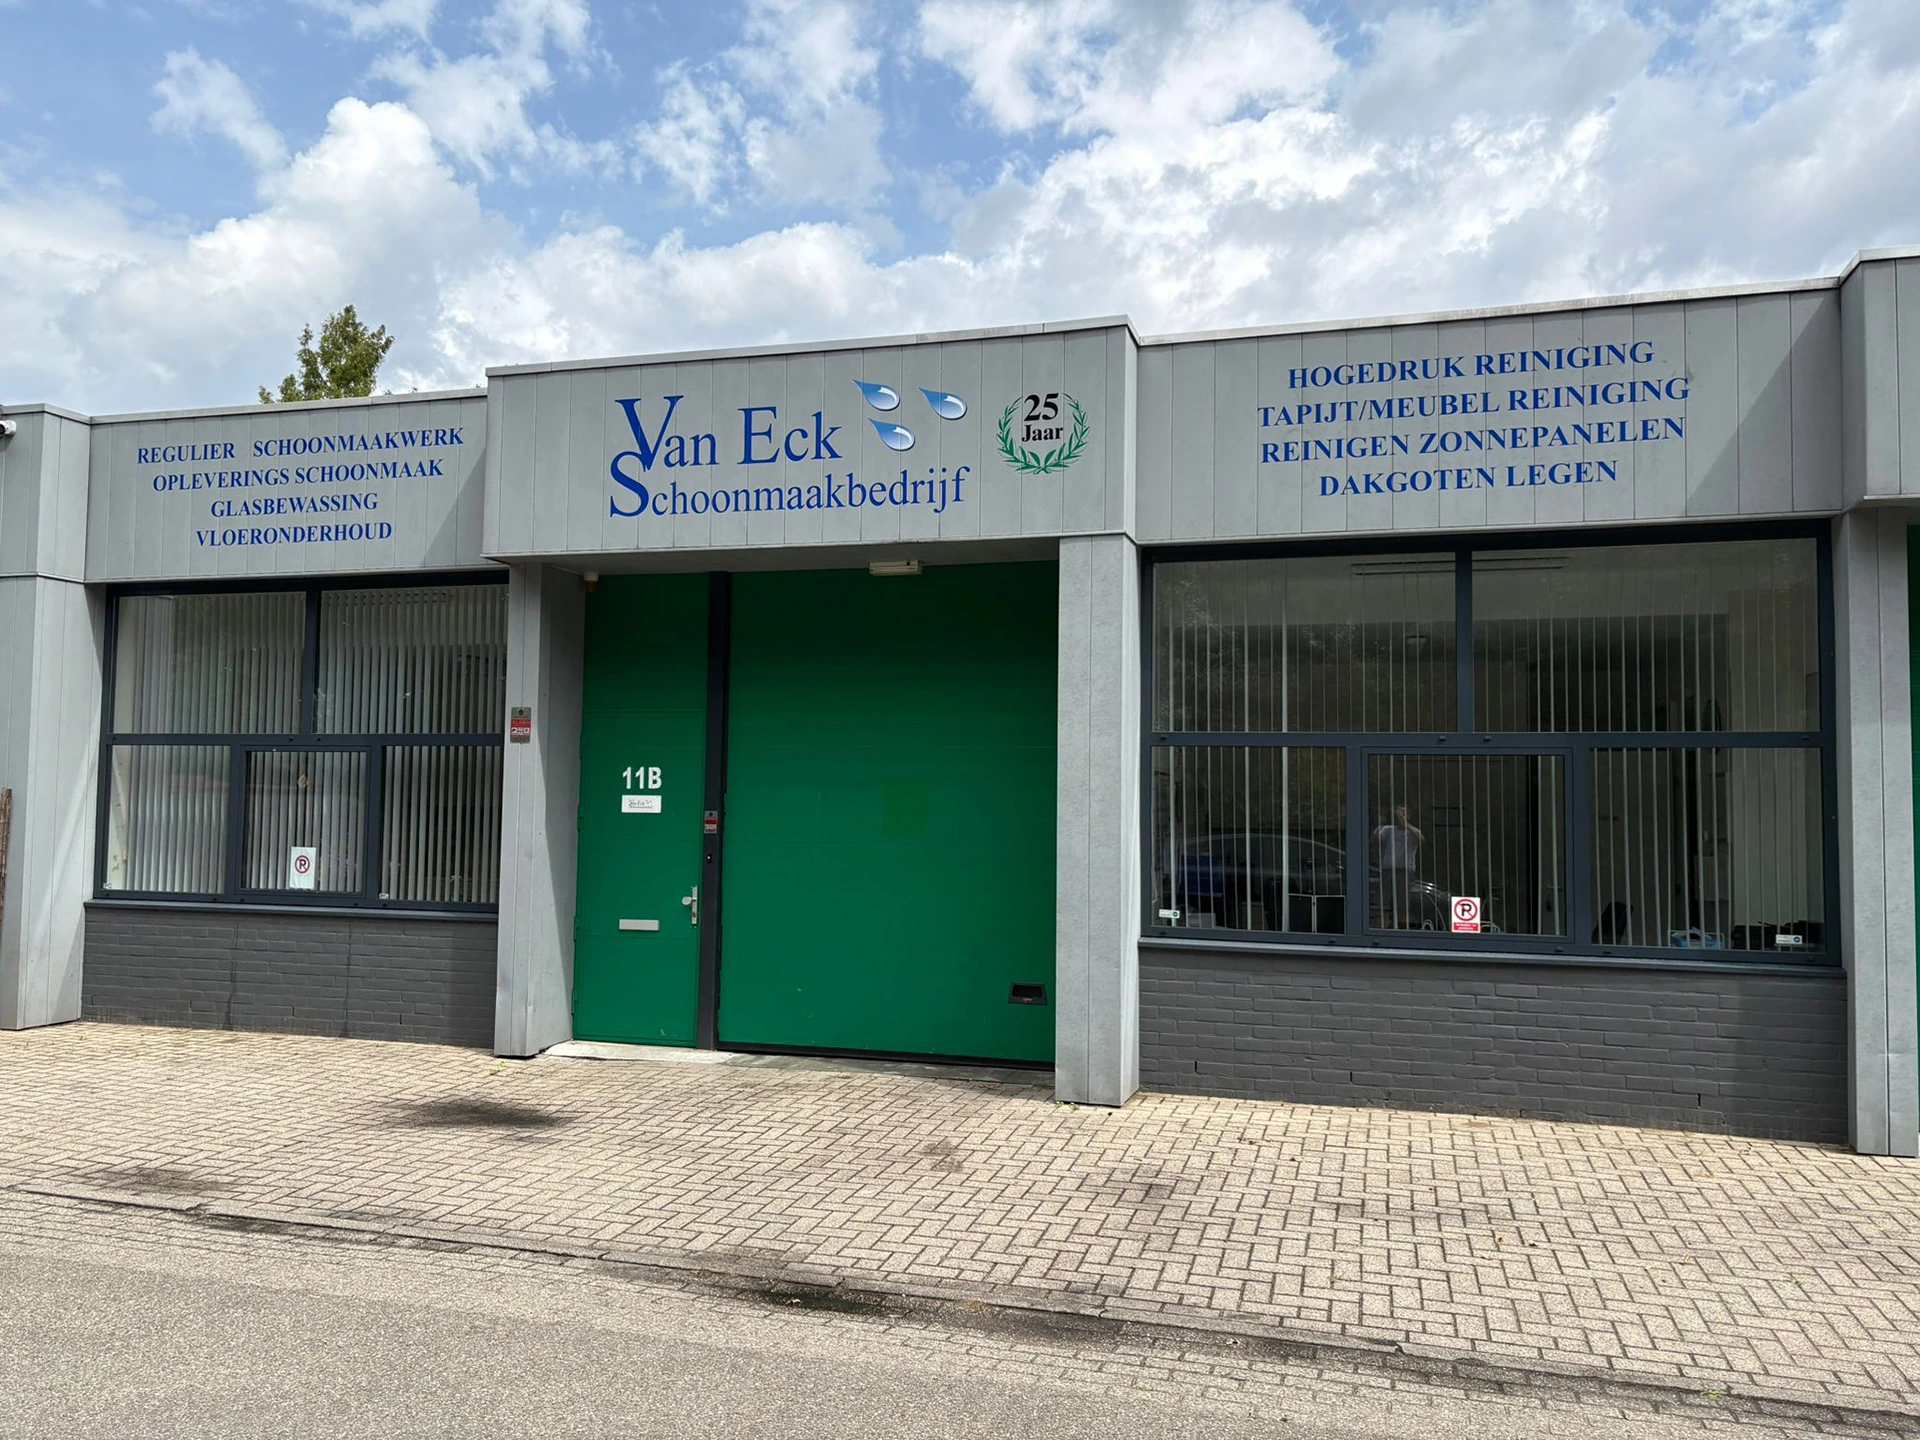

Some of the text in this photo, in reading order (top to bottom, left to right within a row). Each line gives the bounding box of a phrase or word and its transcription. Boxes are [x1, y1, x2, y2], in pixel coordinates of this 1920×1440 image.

[1288, 342, 1654, 389] HOGEDRUK REINIGING
[1024, 392, 1059, 421] 25
[1258, 378, 1689, 427] TAPIJT/MEUBEL REINIGING
[137, 427, 463, 464] REGULIER SCHOONMAAKWERK
[615, 395, 843, 472] Van Eck
[1021, 424, 1064, 443] Jaar
[1261, 417, 1685, 464] REINIGEN ZONNEPANELEN
[153, 459, 443, 492] OPLEVERINGS SCHOONMAAK
[609, 451, 971, 519] Schoonmaakbedrijf
[1319, 460, 1618, 496] DAKGOTEN LEGEN
[210, 493, 379, 518] GLASBEWASSING
[196, 522, 393, 547] VLOERONDERHOUD
[622, 766, 662, 789] 11B
